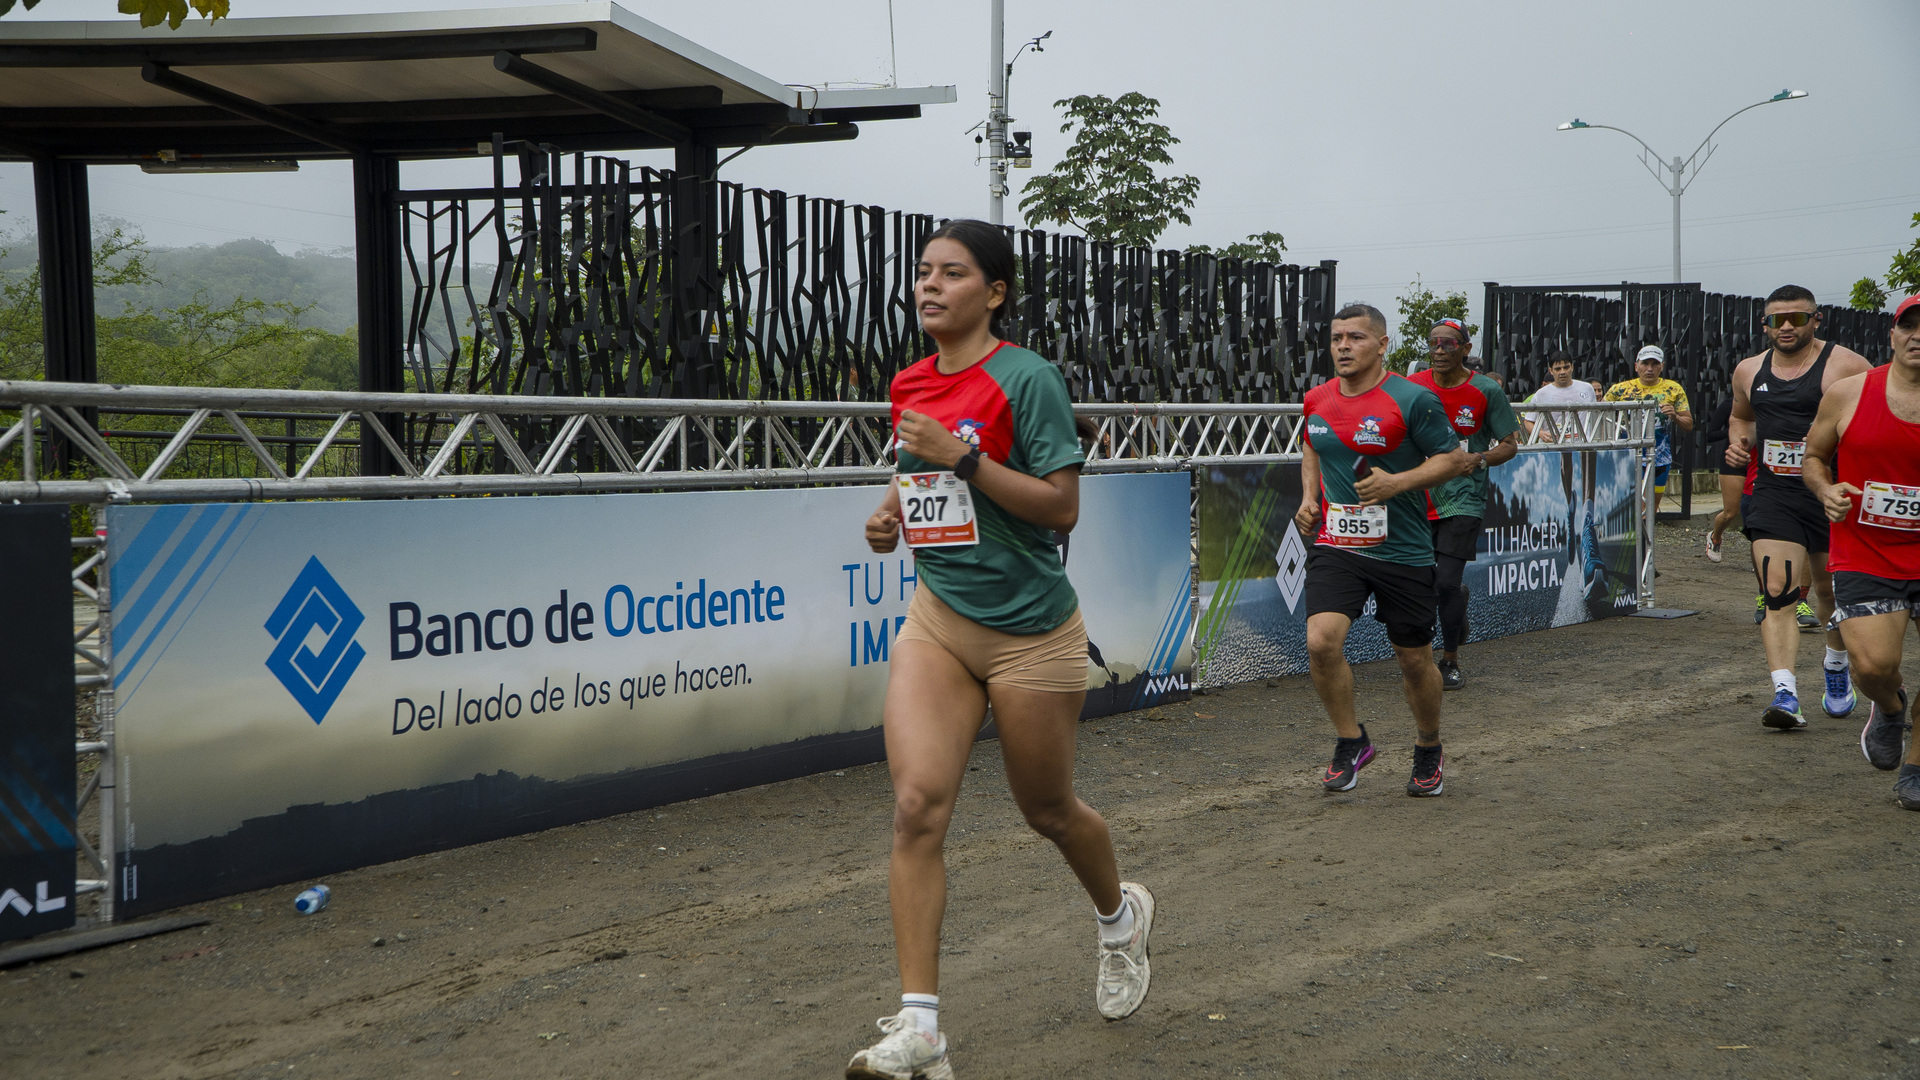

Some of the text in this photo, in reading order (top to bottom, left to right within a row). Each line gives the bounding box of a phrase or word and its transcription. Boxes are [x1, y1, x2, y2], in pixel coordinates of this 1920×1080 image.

[907, 495, 948, 523] 207
[1882, 497, 1920, 517] 759
[1338, 518, 1370, 535] 955
[1485, 521, 1562, 557] TU HACER,
[842, 561, 884, 607] TU
[1488, 558, 1563, 596] IMPACTA.
[1613, 593, 1638, 609] AVAL
[389, 577, 786, 662] Banco de Occidente
[392, 660, 753, 736] Del lado de los que hacen.
[1144, 673, 1189, 696] AVAL
